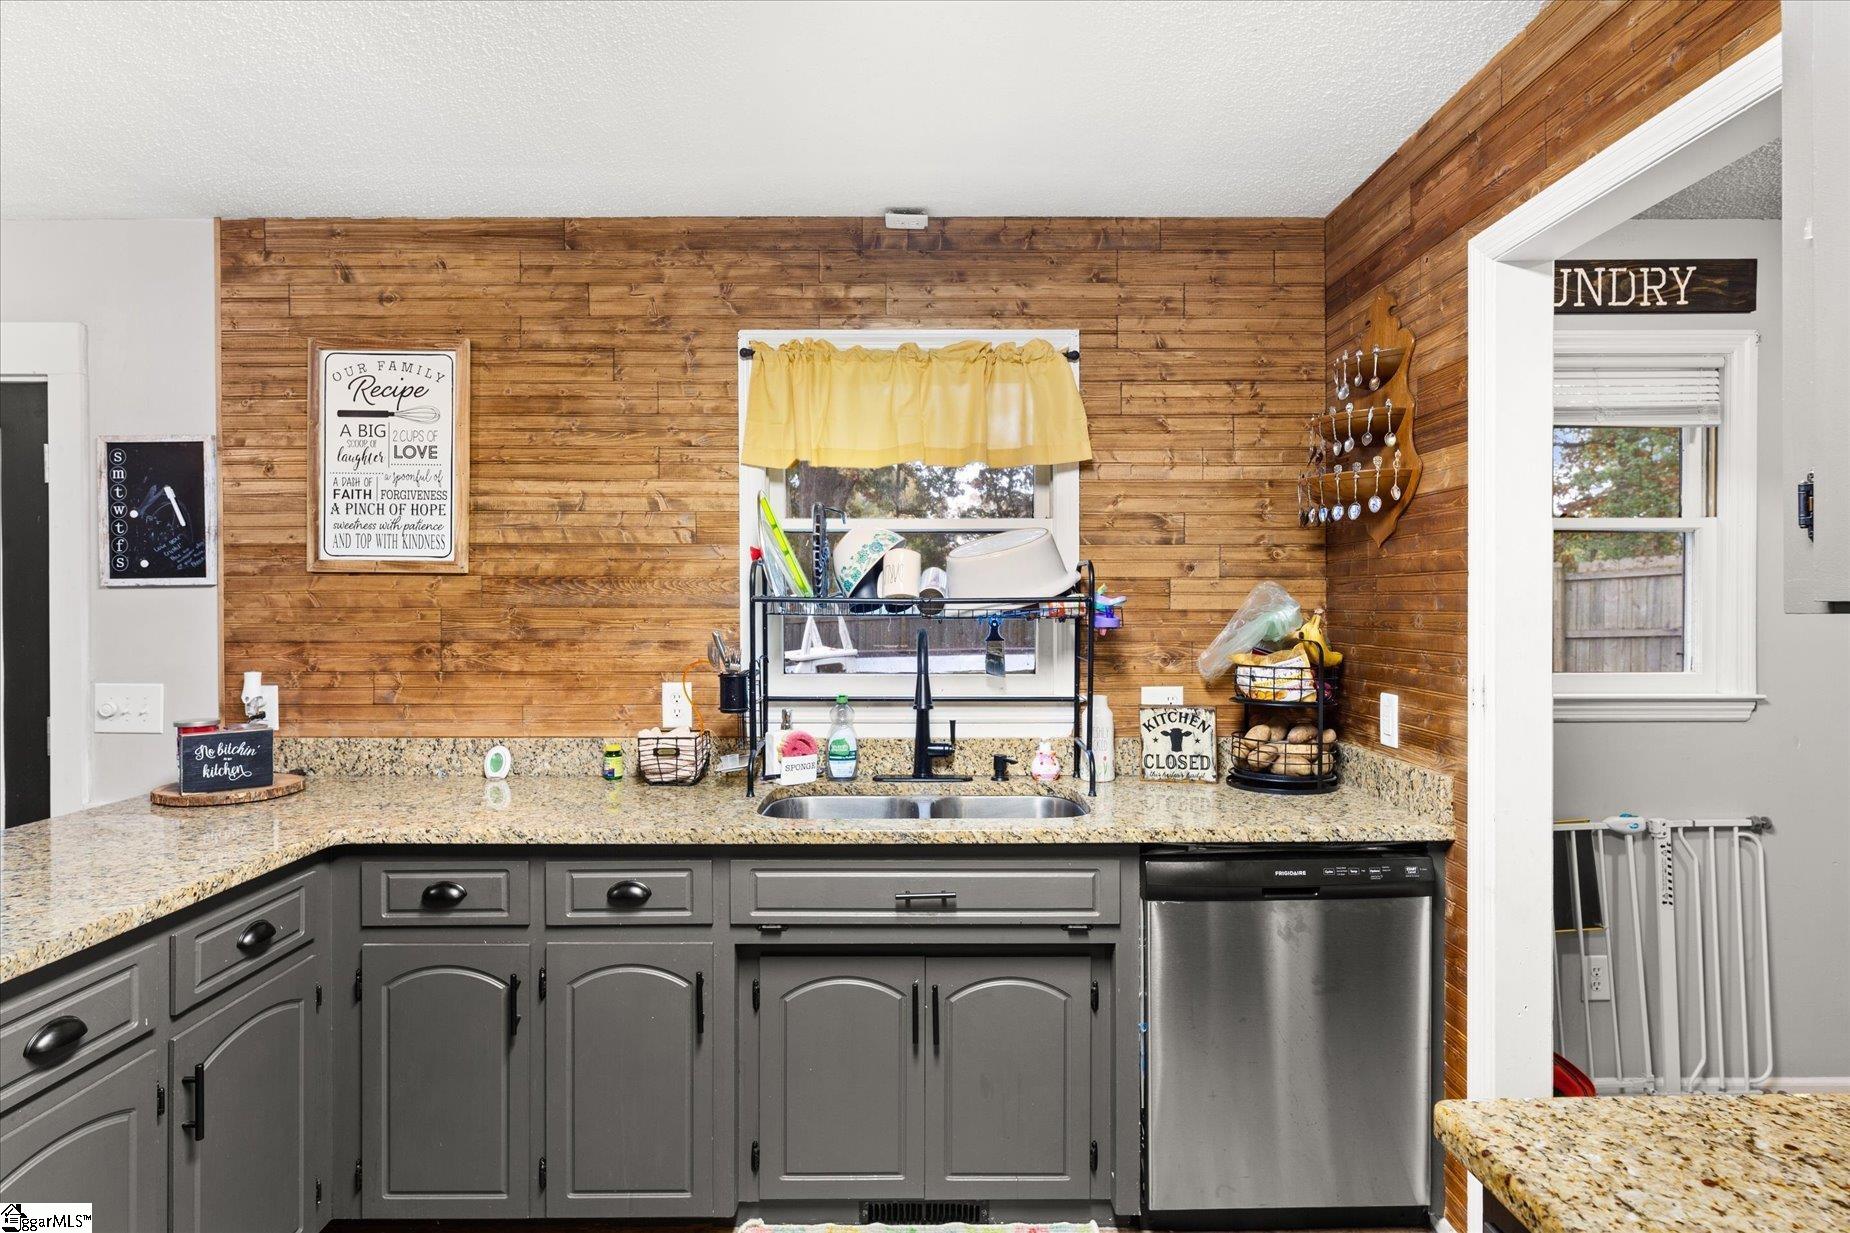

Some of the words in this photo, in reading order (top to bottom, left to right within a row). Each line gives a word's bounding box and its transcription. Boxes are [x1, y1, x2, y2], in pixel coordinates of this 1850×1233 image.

[332, 363, 367, 381] OUR
[377, 361, 445, 383] FAMILY
[348, 375, 429, 410] Recipe
[340, 424, 352, 437] A
[358, 423, 386, 438] BIG
[392, 430, 399, 442] 2
[400, 430, 425, 442] CUPS
[427, 430, 438, 442] OF
[337, 445, 384, 471] laughter
[393, 445, 438, 459] LOVE
[333, 477, 339, 487] A
[363, 477, 373, 487] OF
[392, 469, 432, 487] spoonful
[433, 469, 443, 488] of
[333, 489, 372, 500] FAITH
[380, 490, 448, 500] FORGIVENESS
[330, 503, 340, 515] A
[345, 503, 385, 515] PINCH
[389, 503, 406, 516] OF
[411, 504, 446, 516] HOPE
[333, 518, 377, 530] sweetness
[379, 516, 402, 530] with
[402, 519, 444, 537] patience
[333, 533, 351, 549] AND
[356, 533, 372, 549] TOP
[376, 534, 398, 549] WITH
[402, 534, 446, 550] KINDNESS
[1142, 711, 1211, 733] KITCHEN
[194, 744, 216, 761] No
[785, 762, 816, 772] SPONGE
[1143, 754, 1211, 770] CLOSED
[202, 762, 252, 781] kitchen
